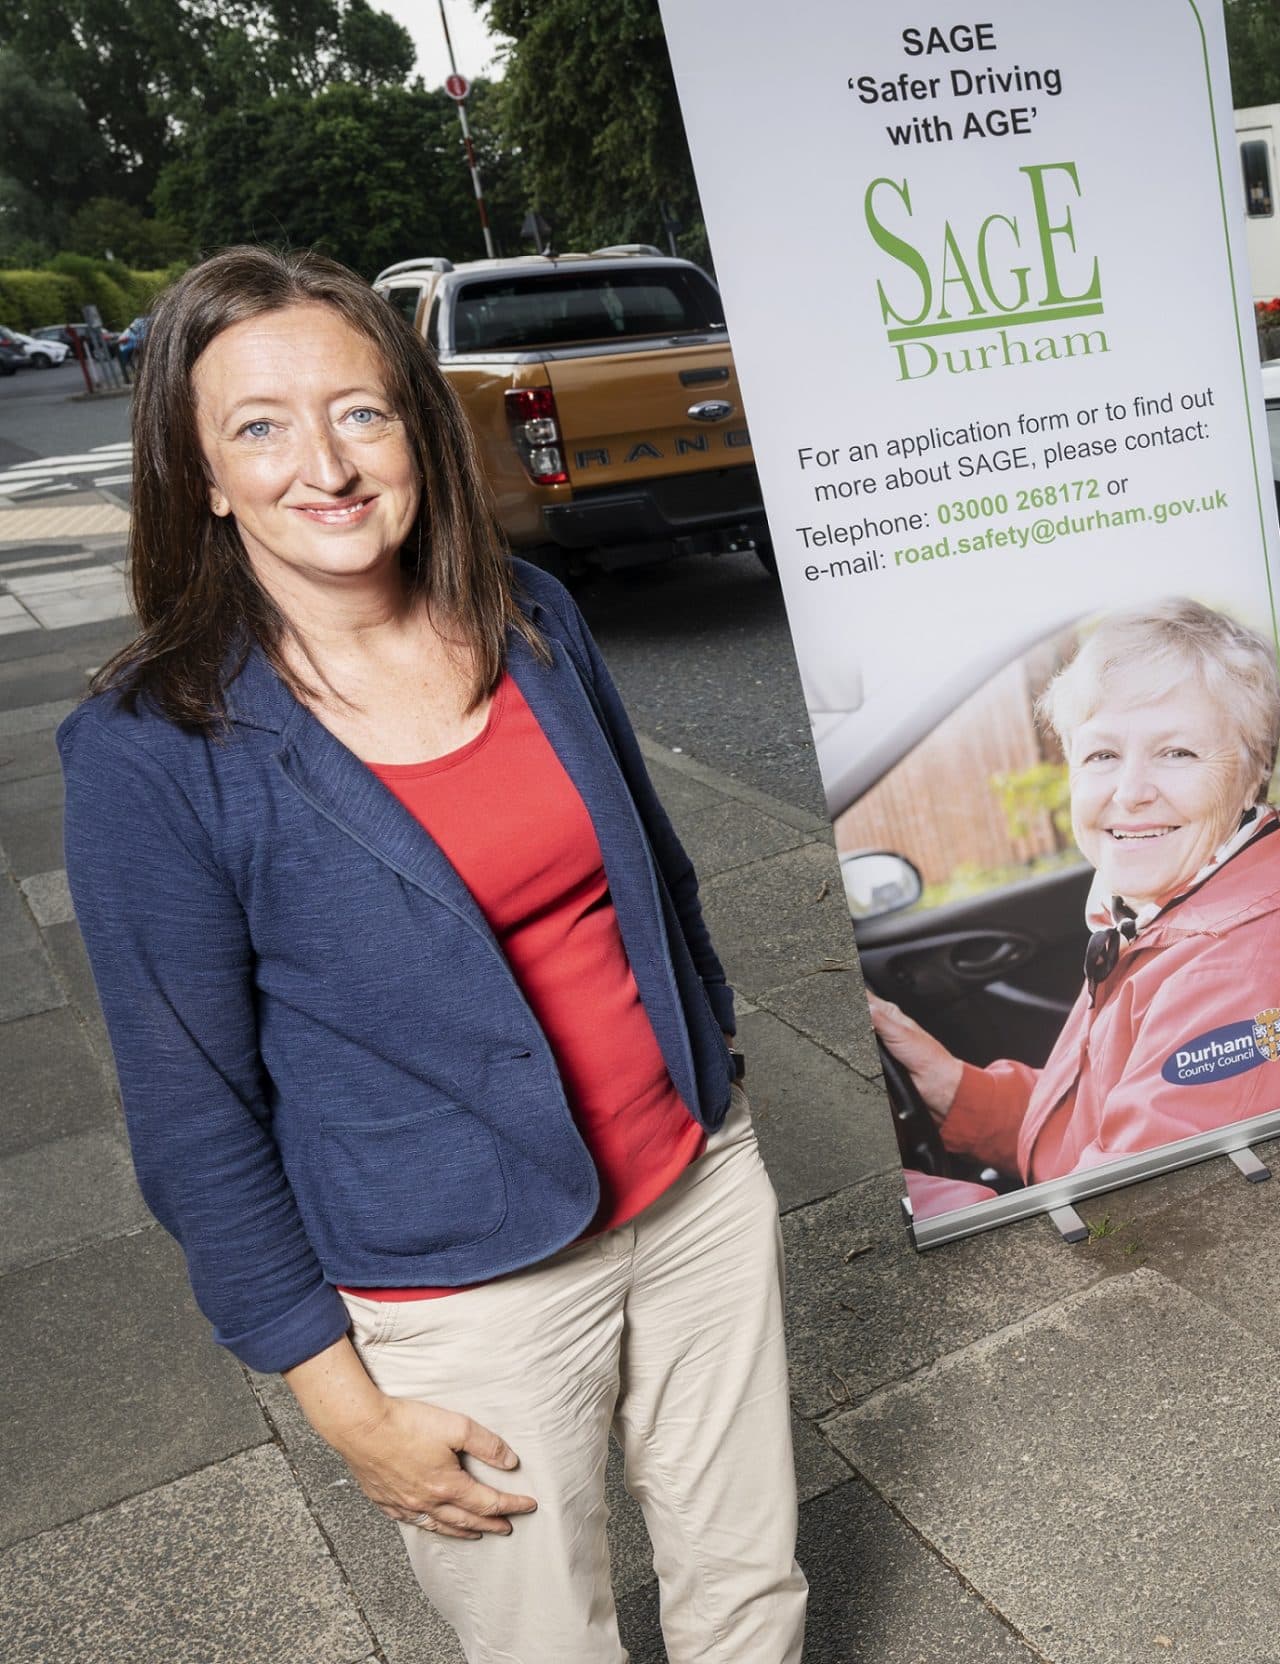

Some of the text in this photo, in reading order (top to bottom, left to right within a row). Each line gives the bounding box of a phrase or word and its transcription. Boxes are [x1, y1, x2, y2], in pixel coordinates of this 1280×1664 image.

[902, 23, 997, 56] SAGE
[949, 65, 1063, 97] Driving
[886, 115, 954, 146] with
[864, 161, 1103, 327] SAGE
[891, 330, 1111, 382] Durham
[798, 387, 1215, 471] For an application form or to find out
[815, 421, 1210, 503] more about SAGE, please contact:
[796, 478, 1129, 549] Telephone: 03000 268172 or
[804, 490, 1229, 582] e-mail: road.safety@durham.gov.uk
[1175, 1033, 1253, 1068] Durham
[1178, 1049, 1255, 1080] County Council
